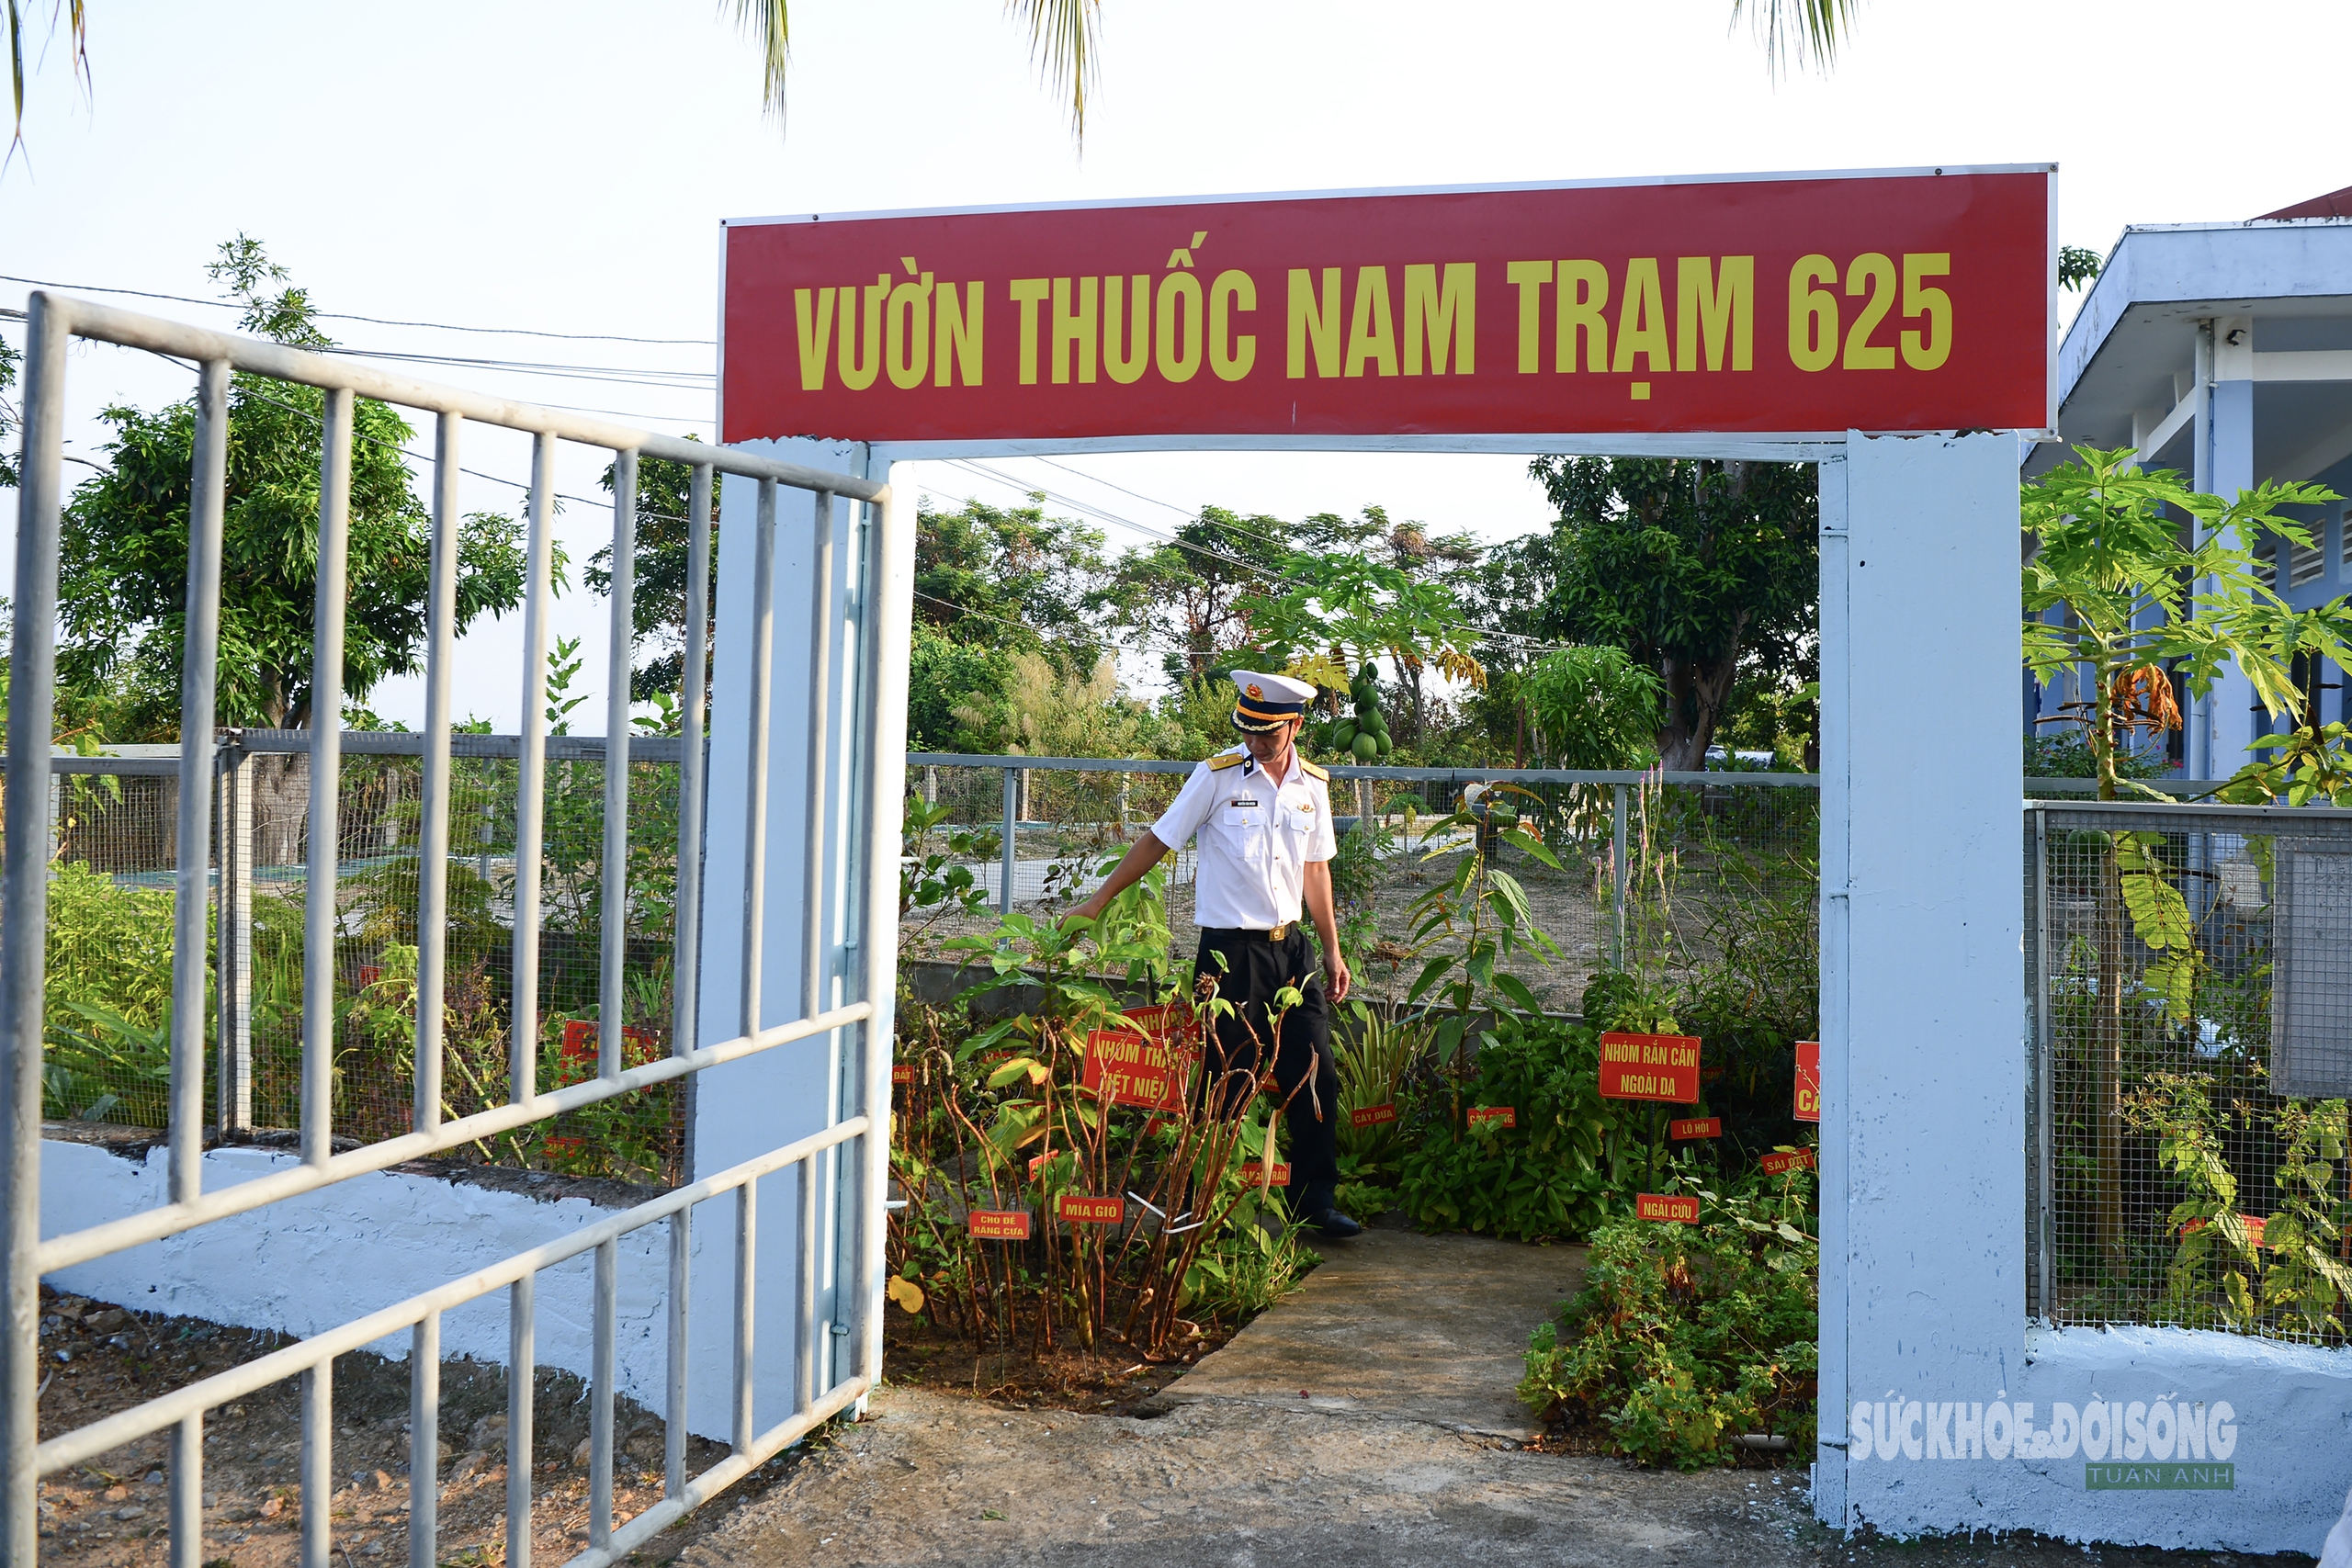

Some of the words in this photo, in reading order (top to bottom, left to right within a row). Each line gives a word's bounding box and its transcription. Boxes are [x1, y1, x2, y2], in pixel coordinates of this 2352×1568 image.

[794, 256, 984, 390] VƯỜN
[1010, 231, 1257, 386] THUỐC
[1287, 263, 1476, 378] NAM
[1507, 255, 1754, 400] TRẠM
[1788, 253, 1952, 372] 625
[1093, 1038, 1139, 1065] NHÓM
[1604, 1040, 1640, 1064] NHÓM
[1643, 1039, 1668, 1066] RẮN
[1670, 1041, 1696, 1067] CẮN
[1133, 1076, 1170, 1103] NIỆU
[1620, 1072, 1657, 1094] NGOÀI
[1659, 1077, 1676, 1096] DA
[1695, 1122, 1710, 1135] HỘI
[1066, 1202, 1091, 1217] MÍA
[1644, 1199, 1668, 1218] NGẢI
[1671, 1203, 1691, 1219] CỨU
